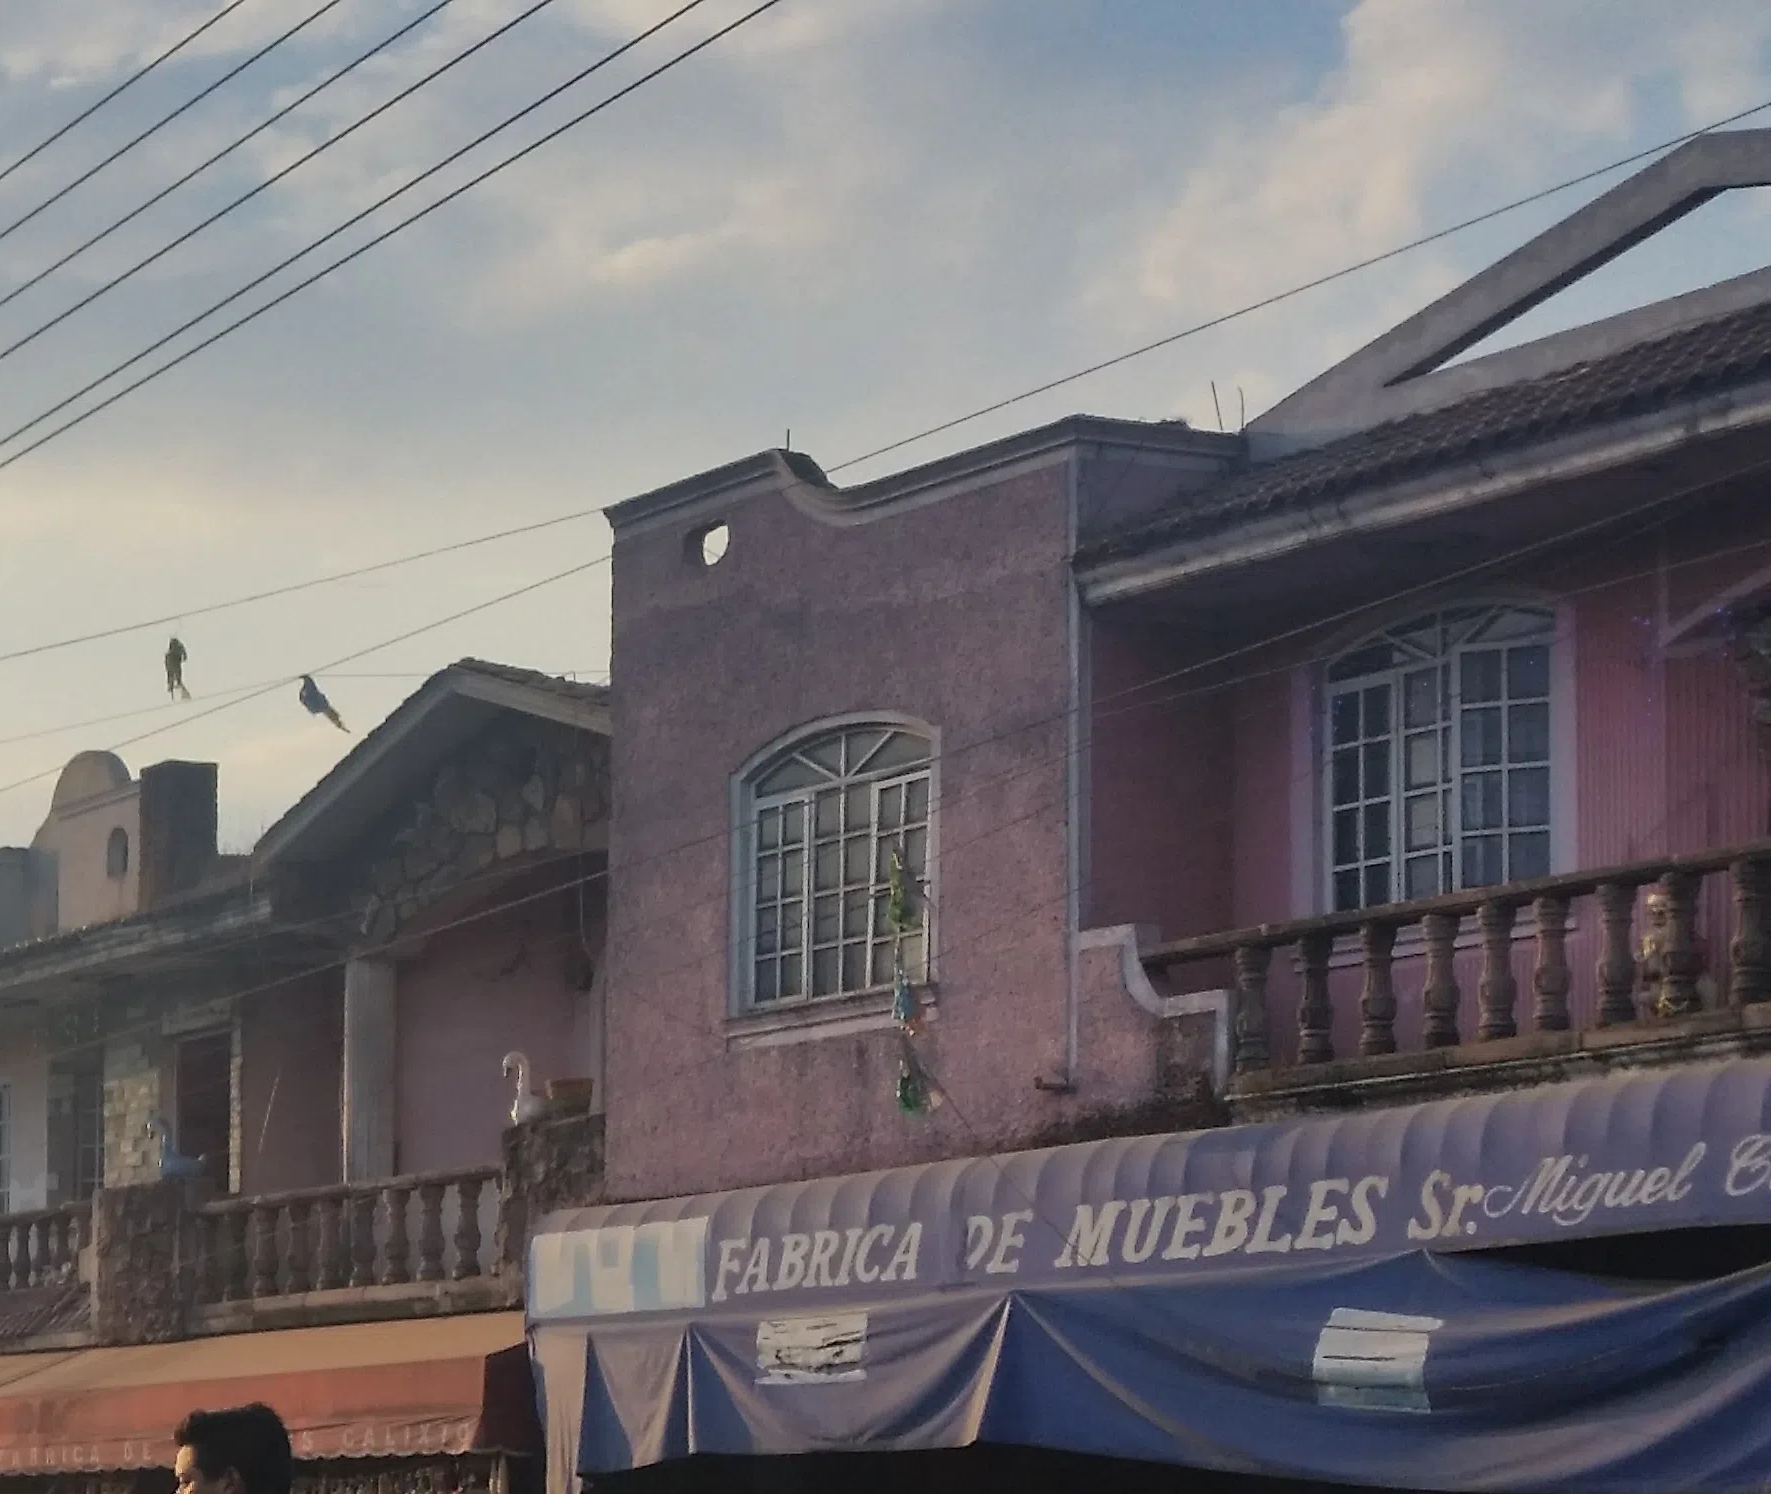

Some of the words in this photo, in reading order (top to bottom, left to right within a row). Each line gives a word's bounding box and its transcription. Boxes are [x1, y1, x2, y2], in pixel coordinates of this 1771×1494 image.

[712, 1223, 922, 1302] FABRICA
[966, 1209, 1034, 1274] DE
[1054, 1175, 1389, 1268] MUEBLES
[1484, 1141, 1707, 1227] Miguel
[124, 1441, 152, 1462] DE
[342, 1422, 469, 1449] CALIXTO
